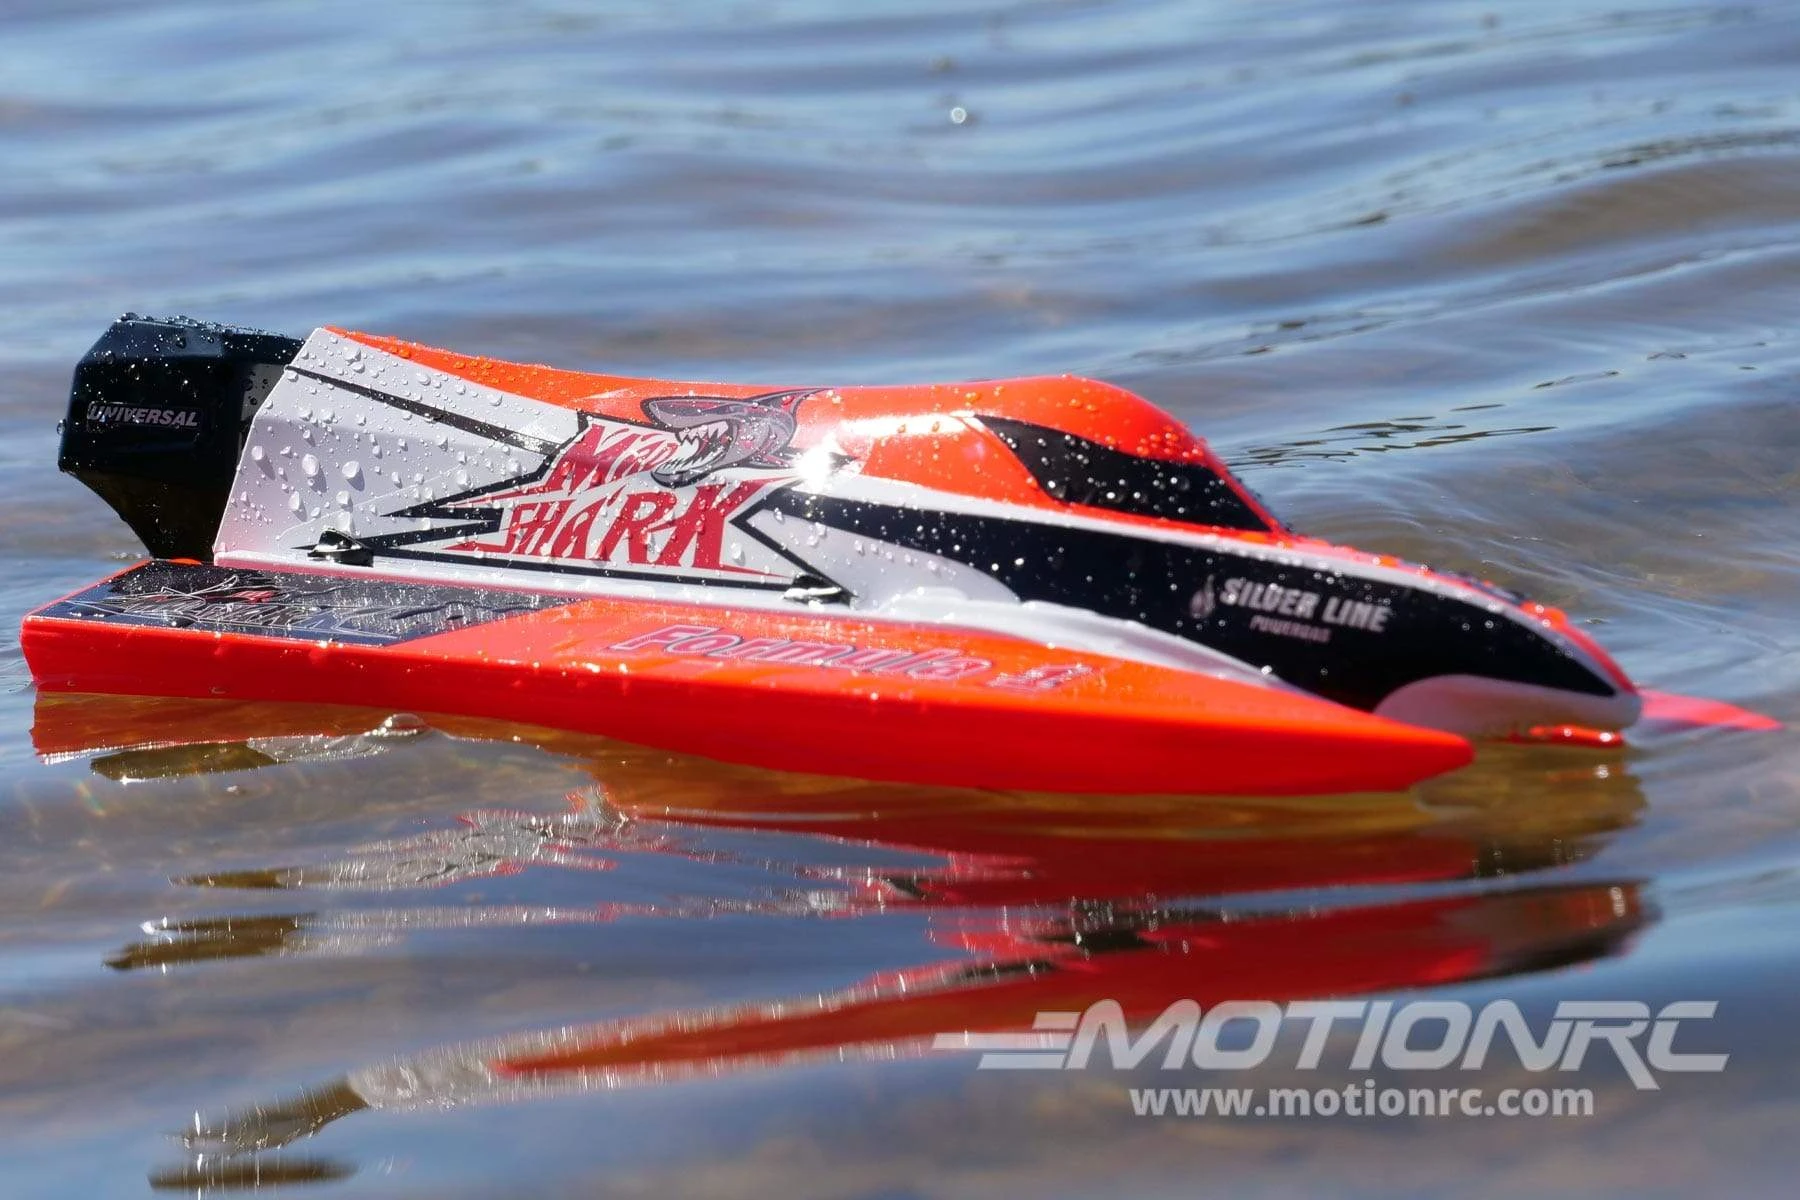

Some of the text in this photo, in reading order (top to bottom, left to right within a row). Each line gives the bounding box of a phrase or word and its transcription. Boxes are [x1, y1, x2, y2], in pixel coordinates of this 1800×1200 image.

[87, 404, 199, 427] UNIVERSAL
[460, 476, 790, 573] SHARK
[1321, 595, 1391, 633] LINE
[608, 623, 993, 684] Formula
